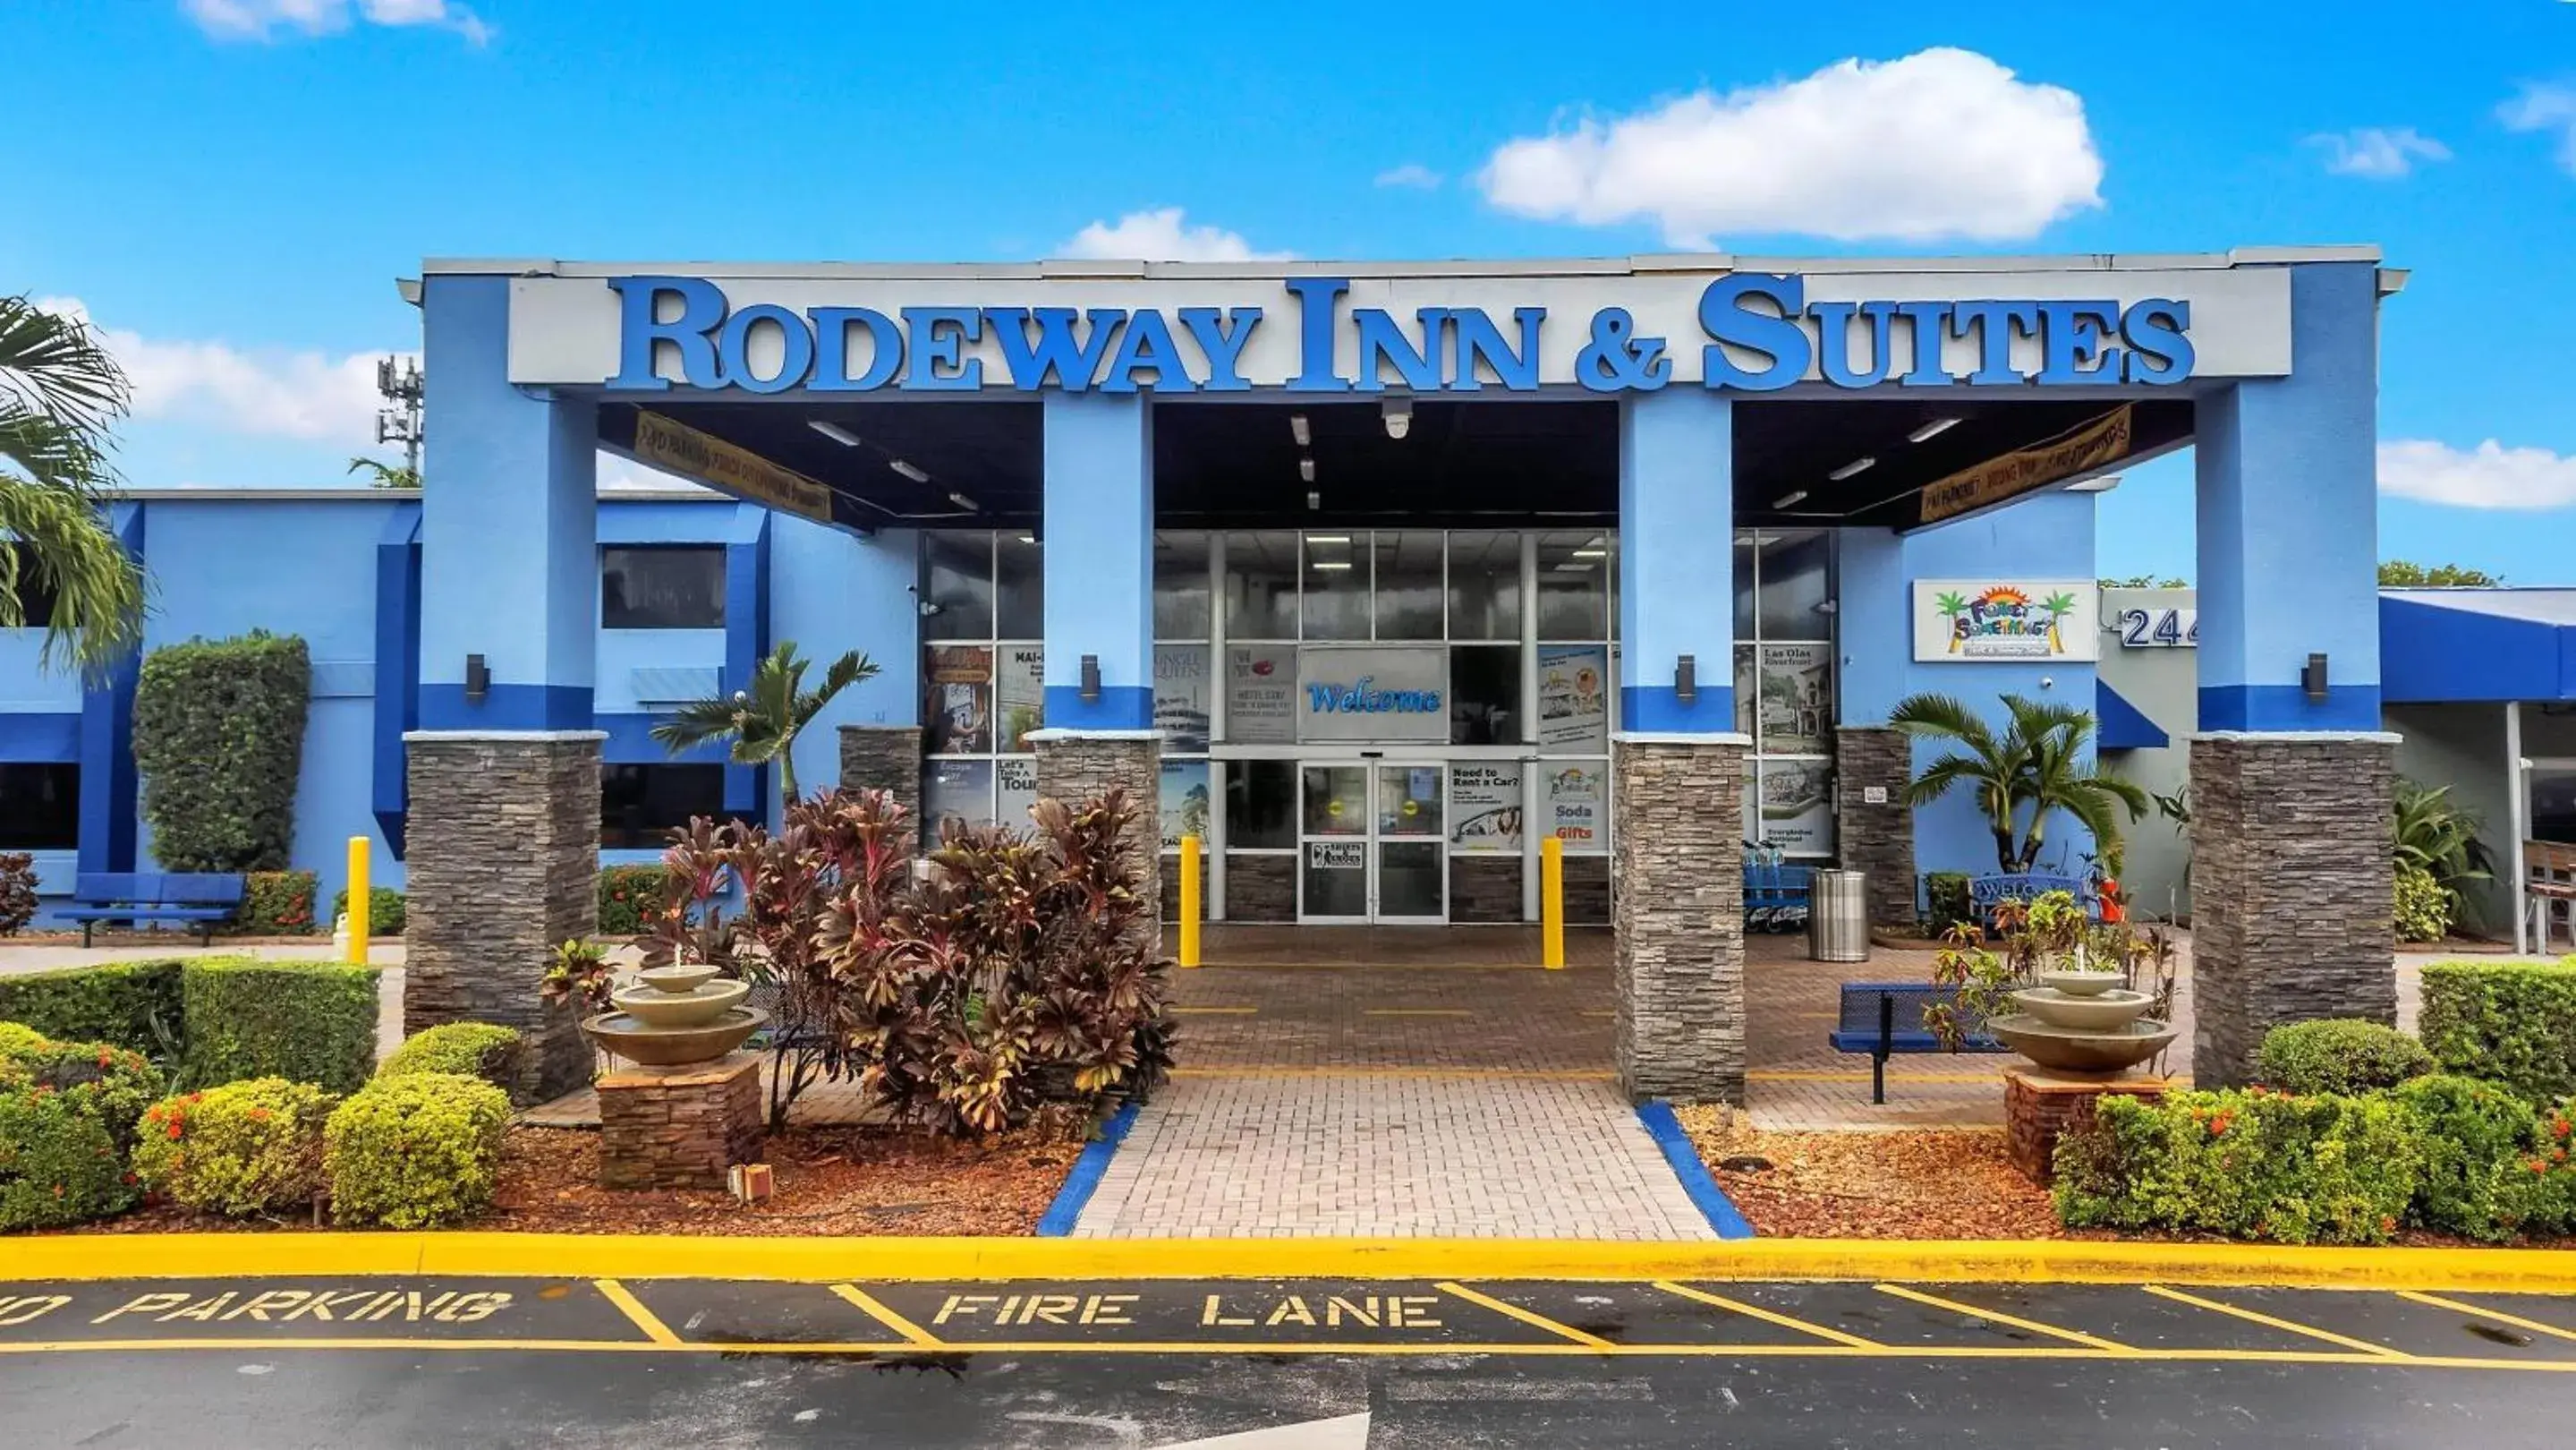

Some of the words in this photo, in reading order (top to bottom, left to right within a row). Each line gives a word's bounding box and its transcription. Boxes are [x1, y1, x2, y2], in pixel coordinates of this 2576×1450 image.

[606, 276, 1262, 394] RODEWAY
[1285, 277, 1546, 392] INN
[1574, 307, 1672, 392] &
[1698, 271, 2195, 391] SUITES
[1306, 674, 1442, 712] Welcome
[1453, 769, 1483, 777] Need
[1485, 769, 1498, 777] to
[1453, 778, 1481, 787] Rent
[1493, 778, 1518, 787] Car?
[1555, 806, 1593, 817] Soda
[1555, 827, 1593, 839] Gifts
[91, 1292, 513, 1324] PARKING
[932, 1294, 1140, 1326] FIRE
[1202, 1294, 1441, 1327] LANE
